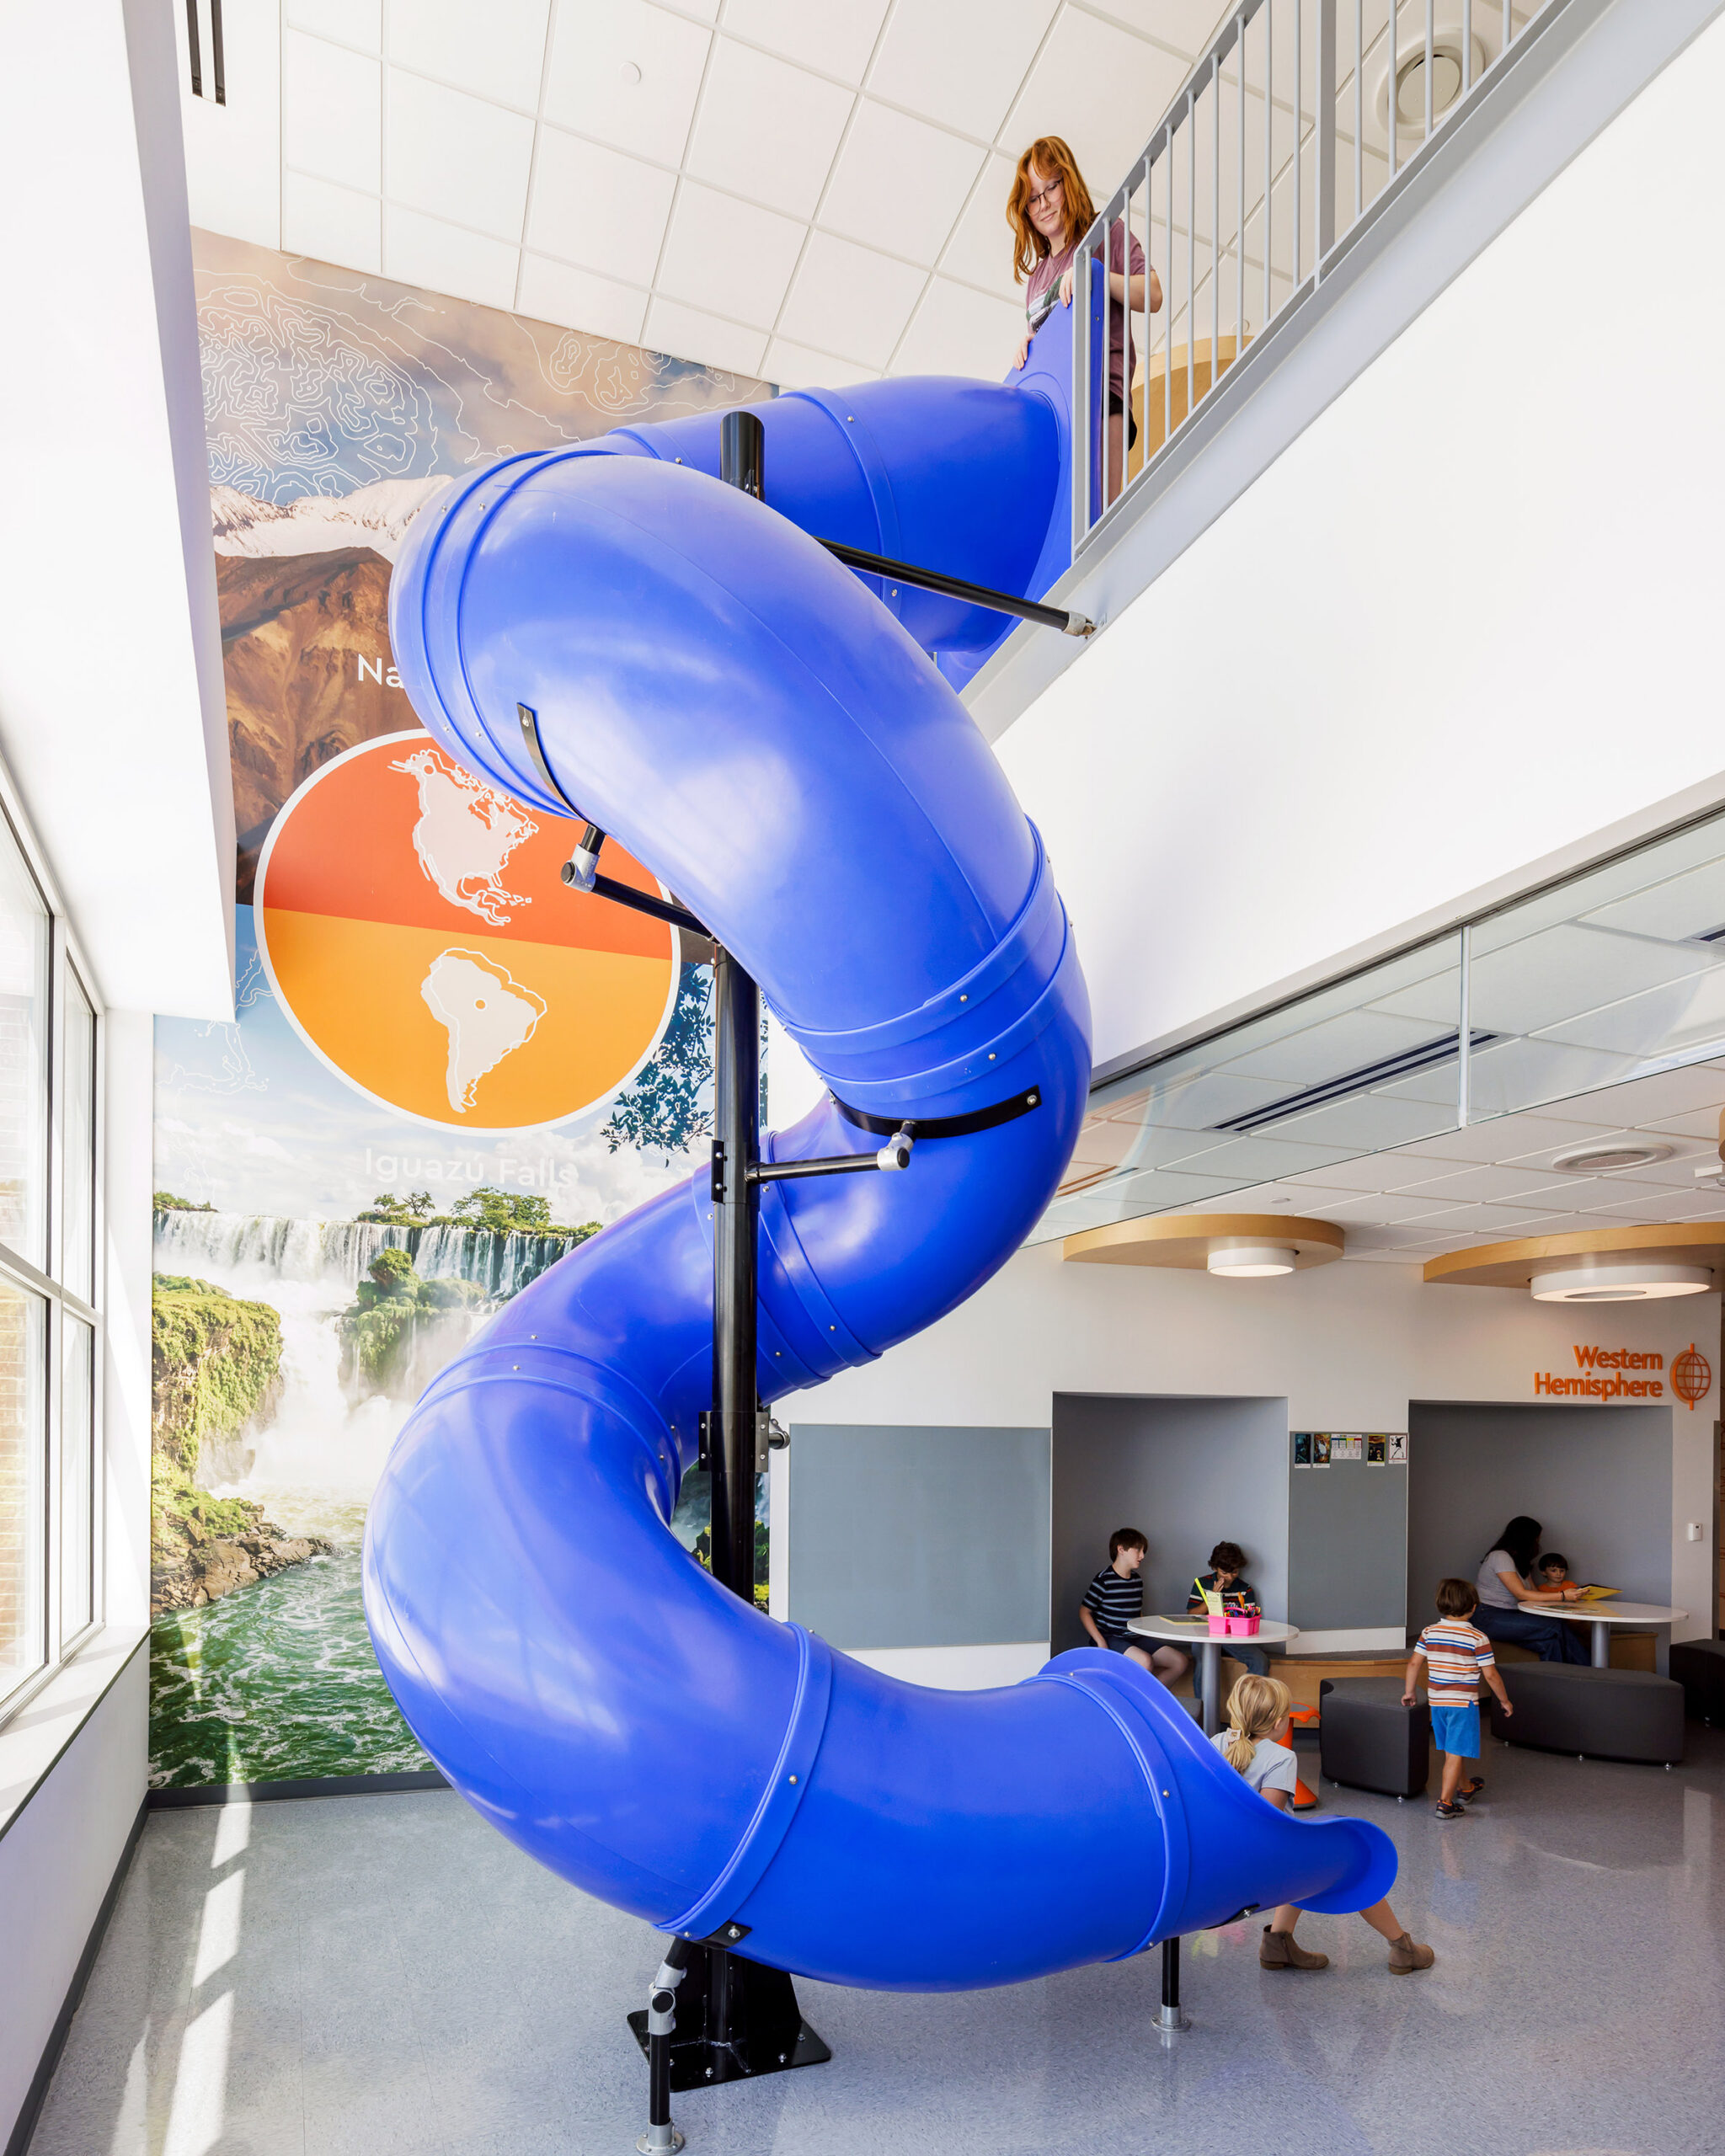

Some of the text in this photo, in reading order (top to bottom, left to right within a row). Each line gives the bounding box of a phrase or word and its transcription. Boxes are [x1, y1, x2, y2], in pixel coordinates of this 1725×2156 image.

[365, 1148, 579, 1188] Iguazú Falls
[1573, 1345, 1663, 1369] Western
[1534, 1371, 1663, 1401] Hemisphere
